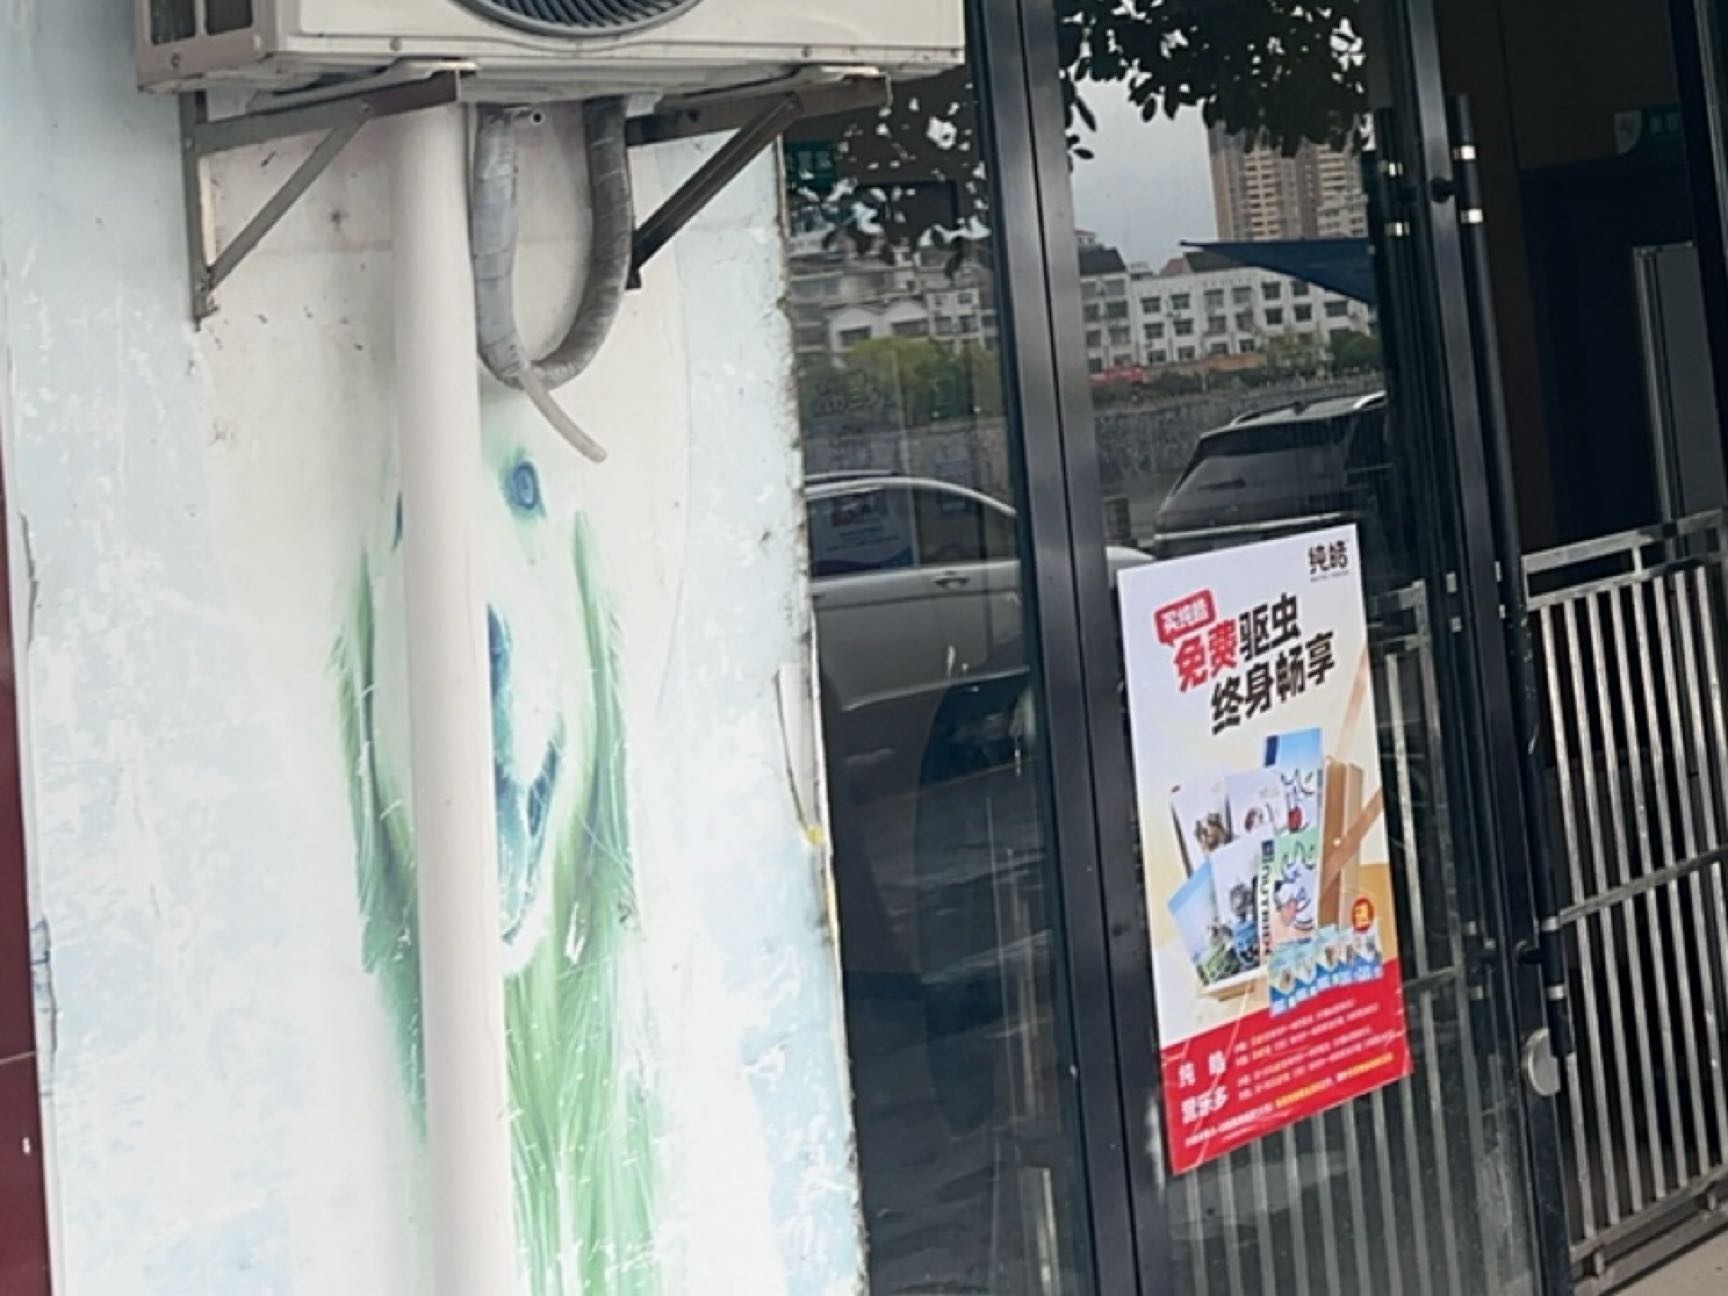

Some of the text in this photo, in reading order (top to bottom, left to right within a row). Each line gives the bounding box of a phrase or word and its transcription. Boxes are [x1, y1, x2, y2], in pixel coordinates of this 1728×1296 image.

[1173, 592, 1302, 693] 免费驱虫
[1210, 630, 1336, 737] 终身畅享
